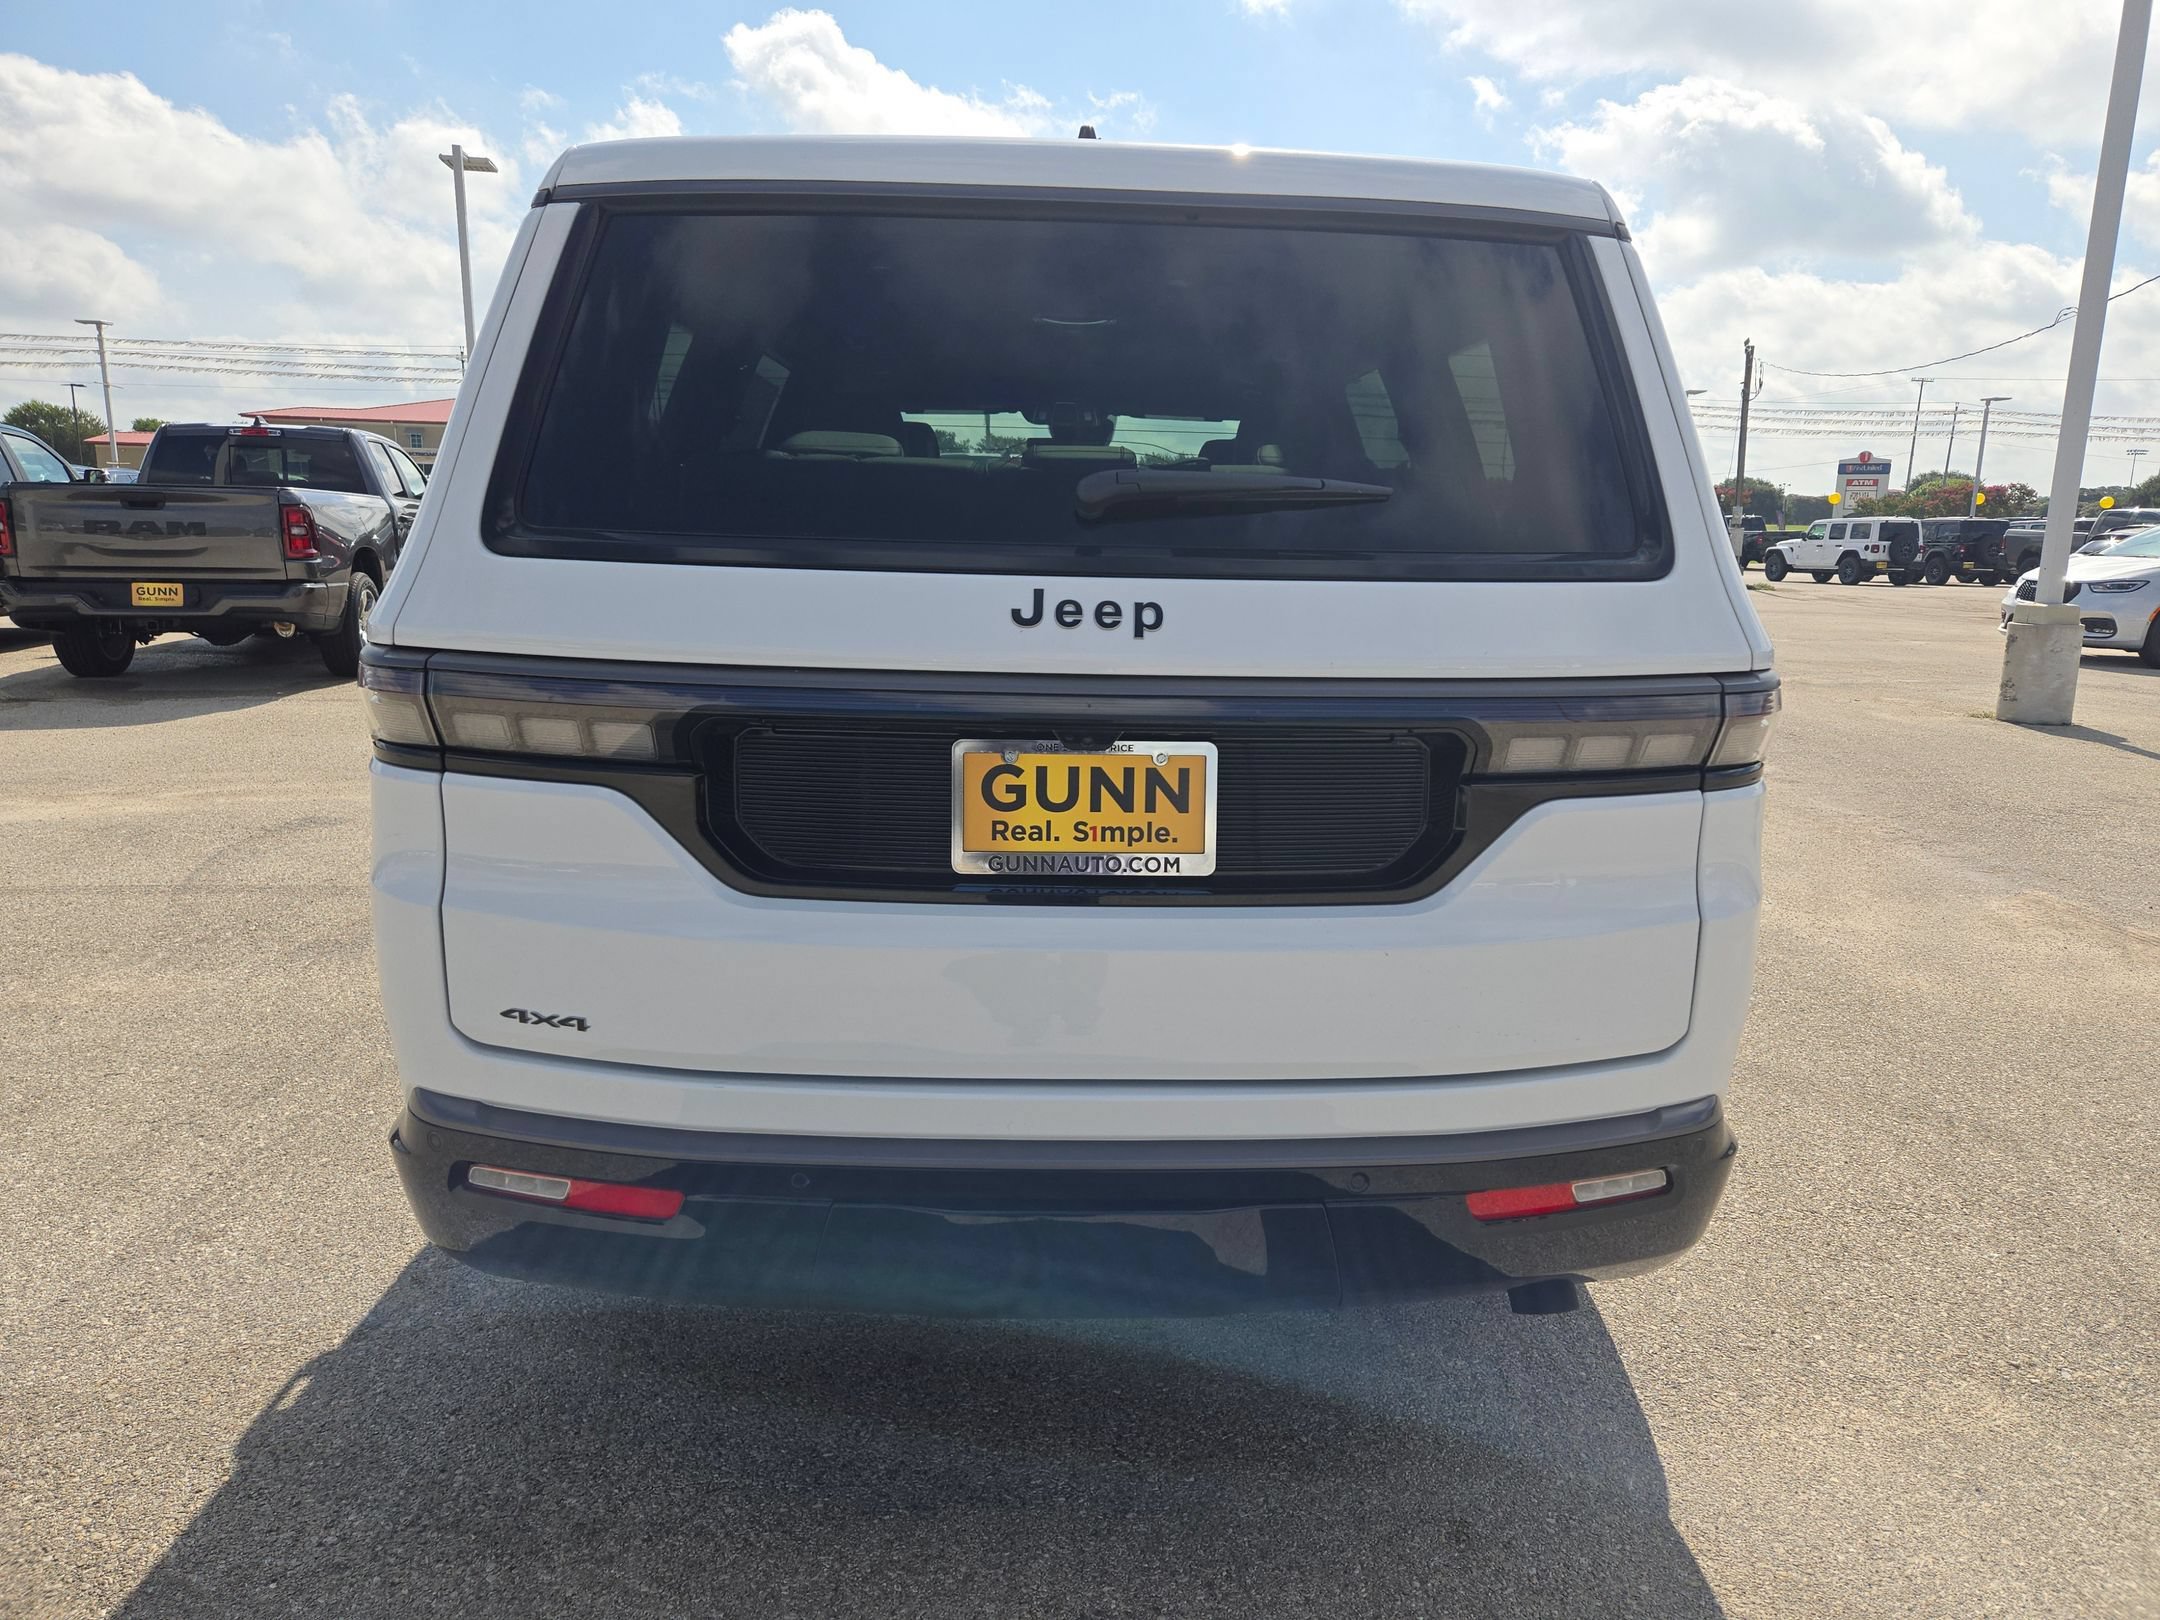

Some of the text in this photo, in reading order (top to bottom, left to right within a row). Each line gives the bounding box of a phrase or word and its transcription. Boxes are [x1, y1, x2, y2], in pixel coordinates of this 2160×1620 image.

[83, 519, 207, 537] RAM
[136, 586, 178, 597] GUNN
[1011, 588, 1164, 640] Jeep
[1036, 743, 1134, 753] ONE RICE
[981, 764, 1190, 814] GUNN
[991, 820, 1060, 842] Real.
[988, 855, 1181, 874] GUNNAUTO.COM
